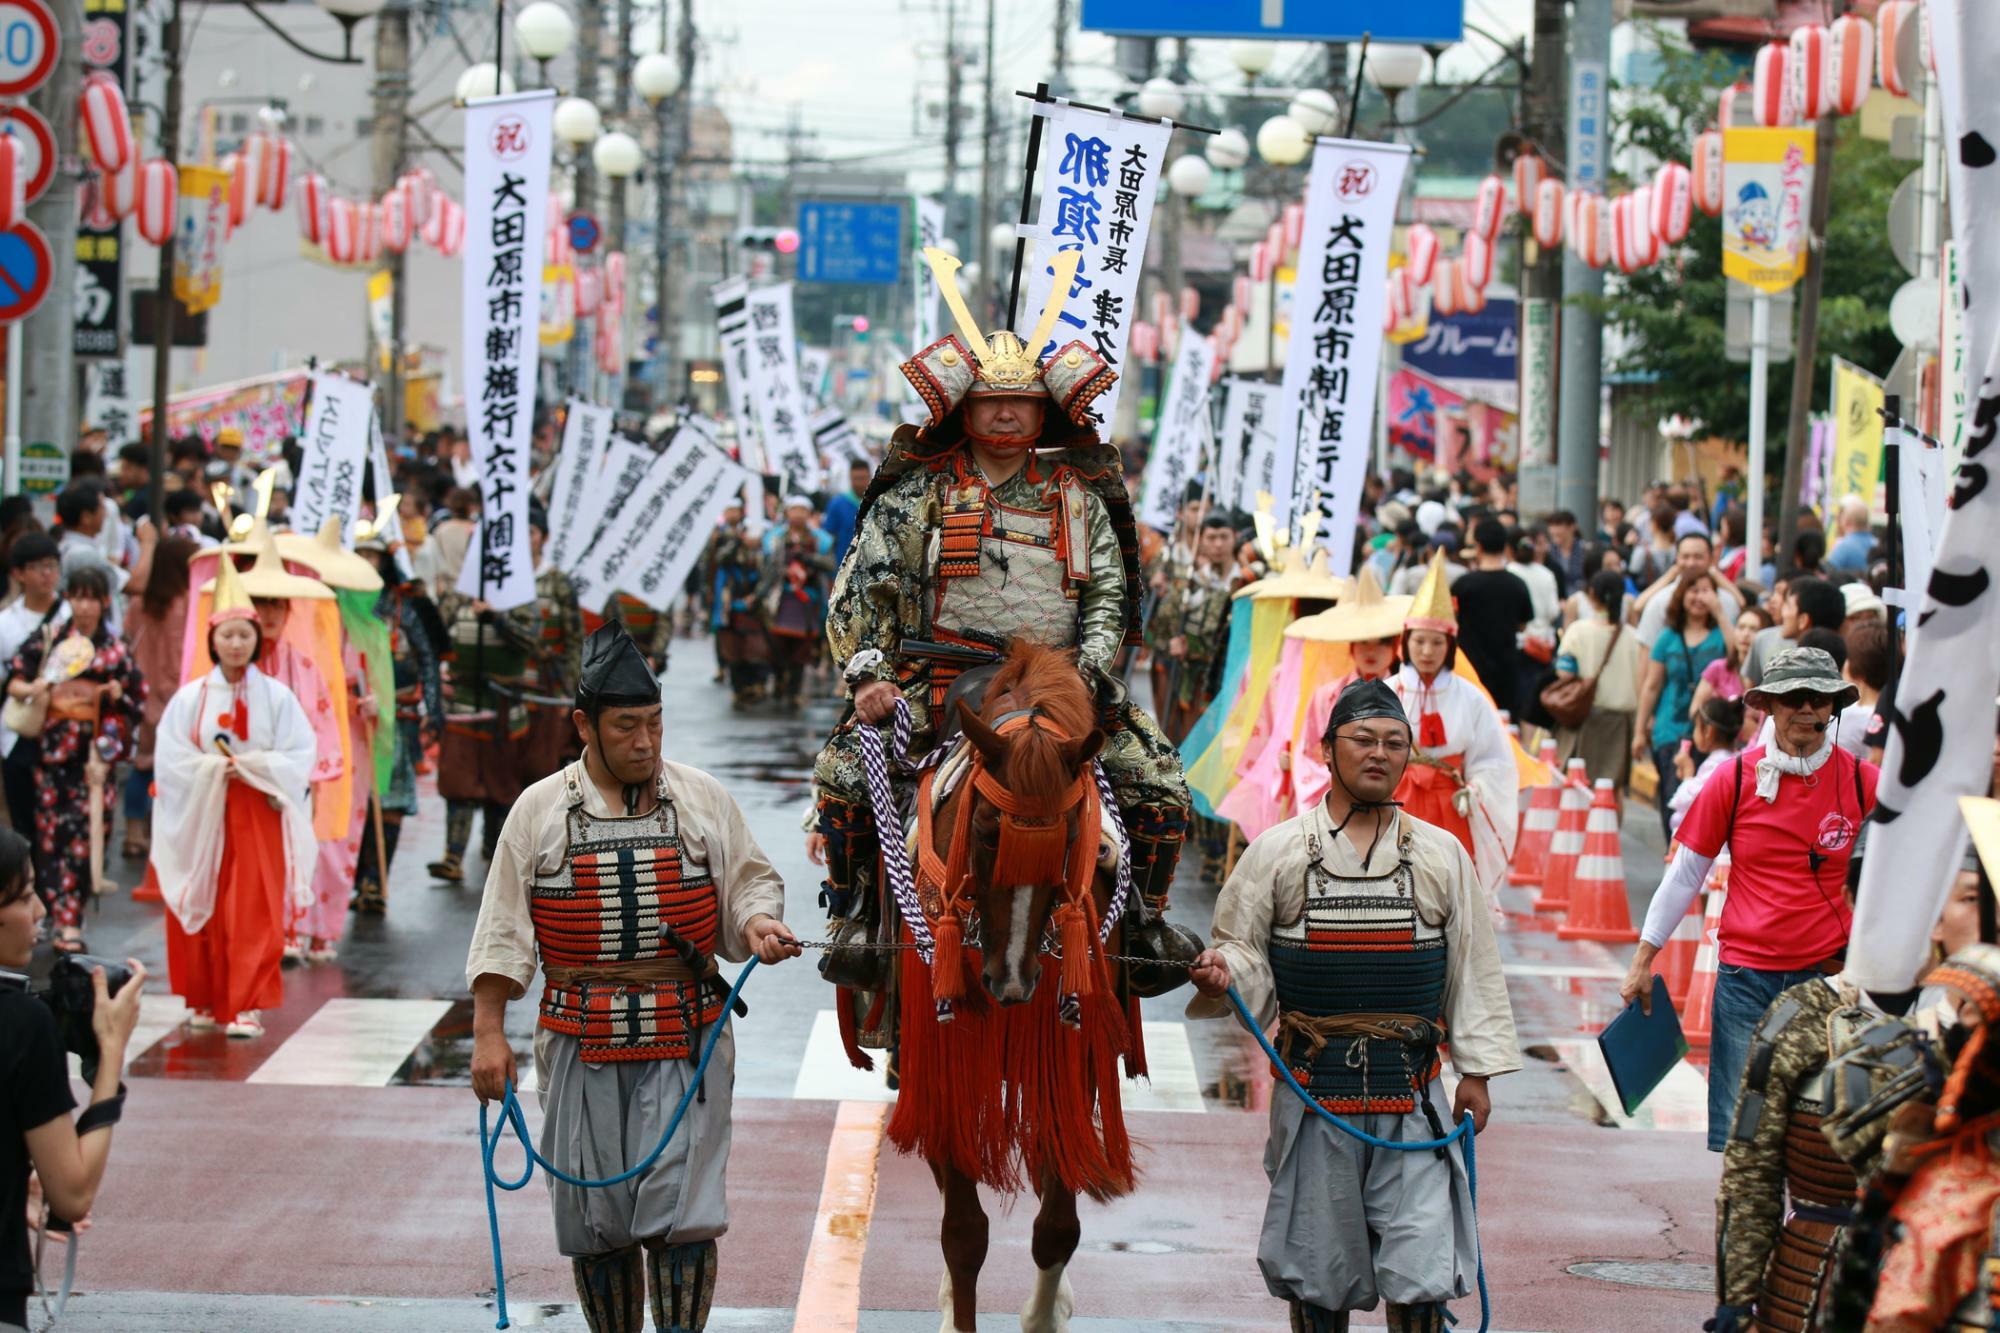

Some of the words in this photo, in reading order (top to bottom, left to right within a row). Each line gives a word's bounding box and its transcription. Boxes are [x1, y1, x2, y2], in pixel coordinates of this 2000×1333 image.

[496, 123, 527, 154] 祝
[1338, 166, 1371, 197] 祝
[482, 172, 527, 590] 大田原市制施行六十周年
